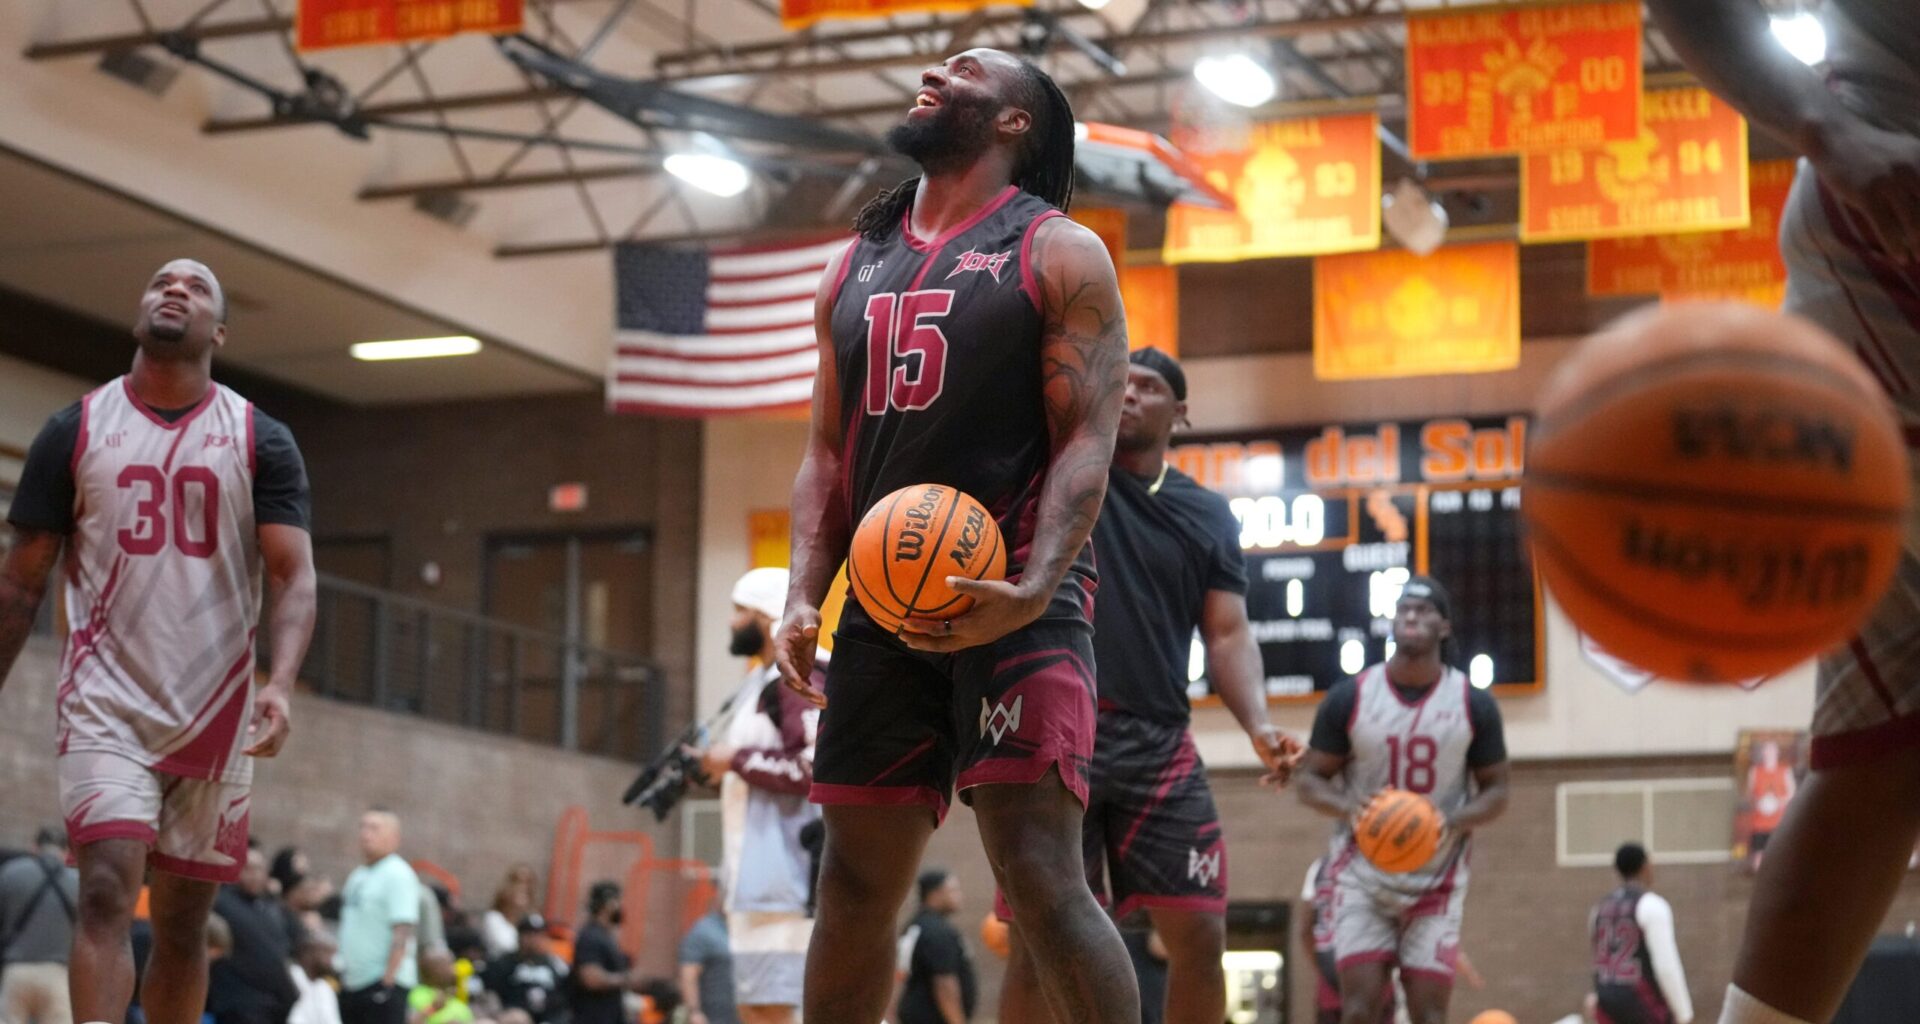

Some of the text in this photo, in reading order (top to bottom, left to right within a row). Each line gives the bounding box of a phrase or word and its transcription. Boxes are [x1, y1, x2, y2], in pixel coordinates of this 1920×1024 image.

[864, 289, 955, 416] 15
[1304, 424, 1399, 486] del
[1420, 419, 1526, 482] Sol
[117, 464, 219, 558] 30
[895, 486, 945, 562] Wilson
[950, 505, 986, 570] NCAA
[1386, 735, 1438, 794] 18
